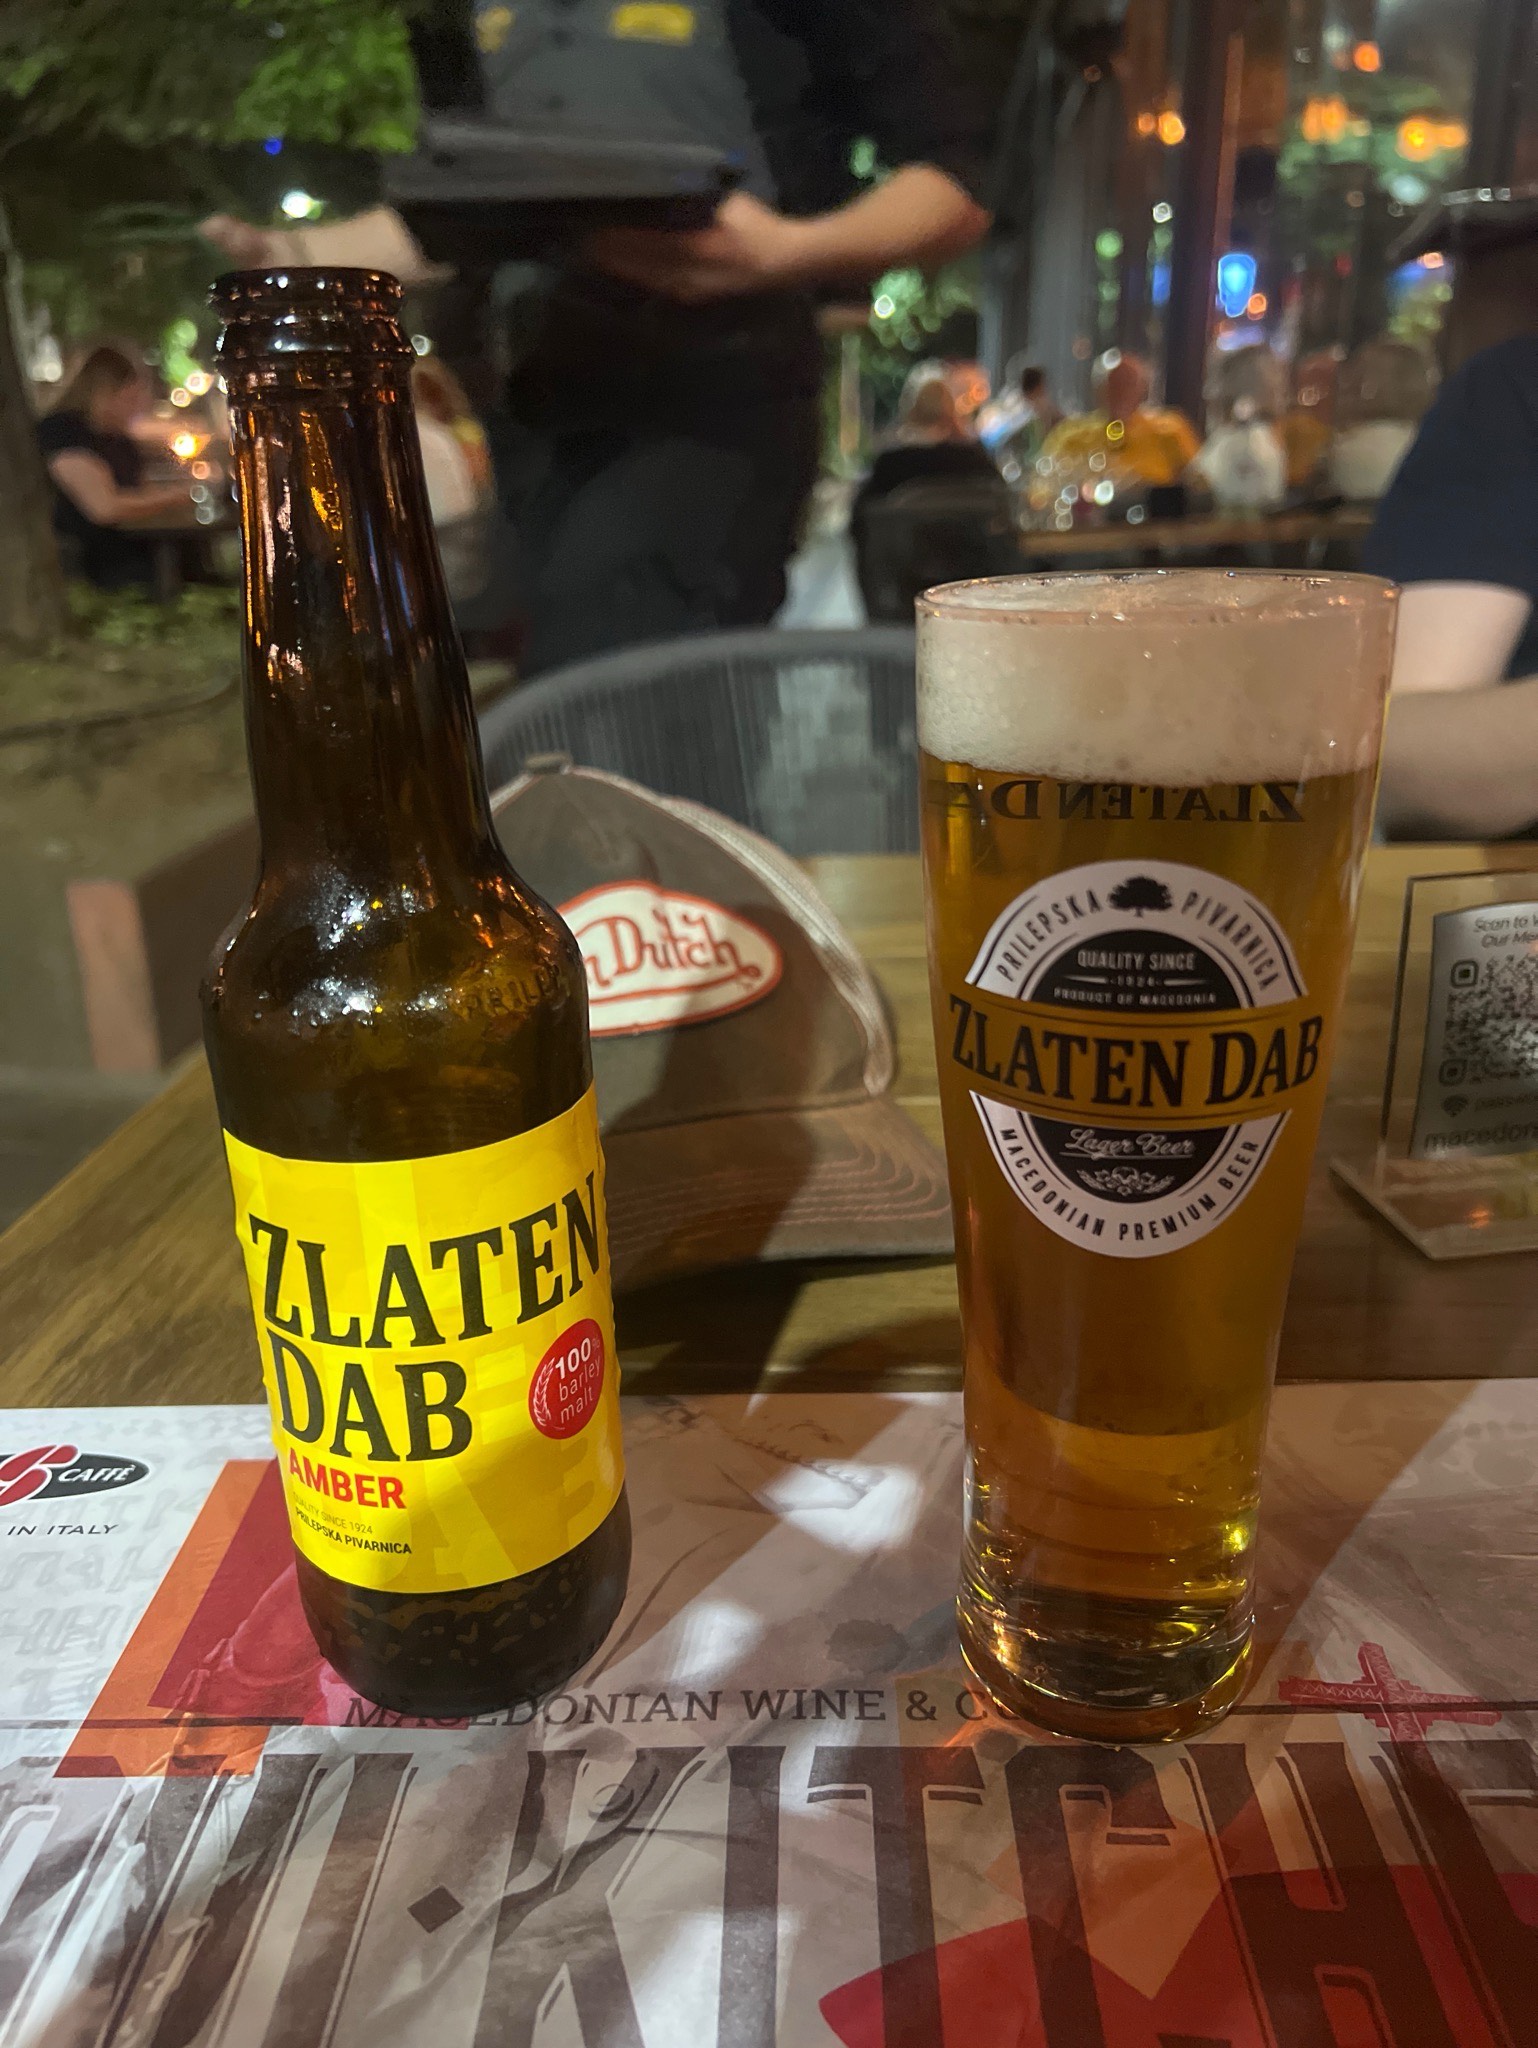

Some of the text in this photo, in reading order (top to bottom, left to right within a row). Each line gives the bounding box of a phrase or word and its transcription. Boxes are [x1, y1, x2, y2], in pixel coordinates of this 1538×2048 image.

[576, 909, 741, 976] Dutch
[996, 889, 1280, 991] PRILEPSKA PIVARNICA
[1077, 950, 1196, 971] QUALITY SINCE
[1054, 987, 1112, 1003] PRODUCT
[949, 994, 1324, 1107] ZLATEN DAB
[1064, 1128, 1195, 1161] Lager Beer
[1000, 1128, 1260, 1241] MACEDONIAN PREMIUM BEER
[248, 1170, 601, 1349] ZLATEN
[265, 1327, 473, 1463] DAB
[558, 1355, 601, 1402] barley
[560, 1386, 594, 1424] malt
[288, 1448, 407, 1509] AMBER
[7, 1524, 119, 1536] IN ITALY
[295, 1506, 413, 1555] PRILEPSKA PIVARNICA
[321, 1510, 349, 1529] SINCE
[349, 1521, 373, 1535] 1924
[738, 1689, 886, 1721] WINE
[905, 1690, 938, 1721] &
